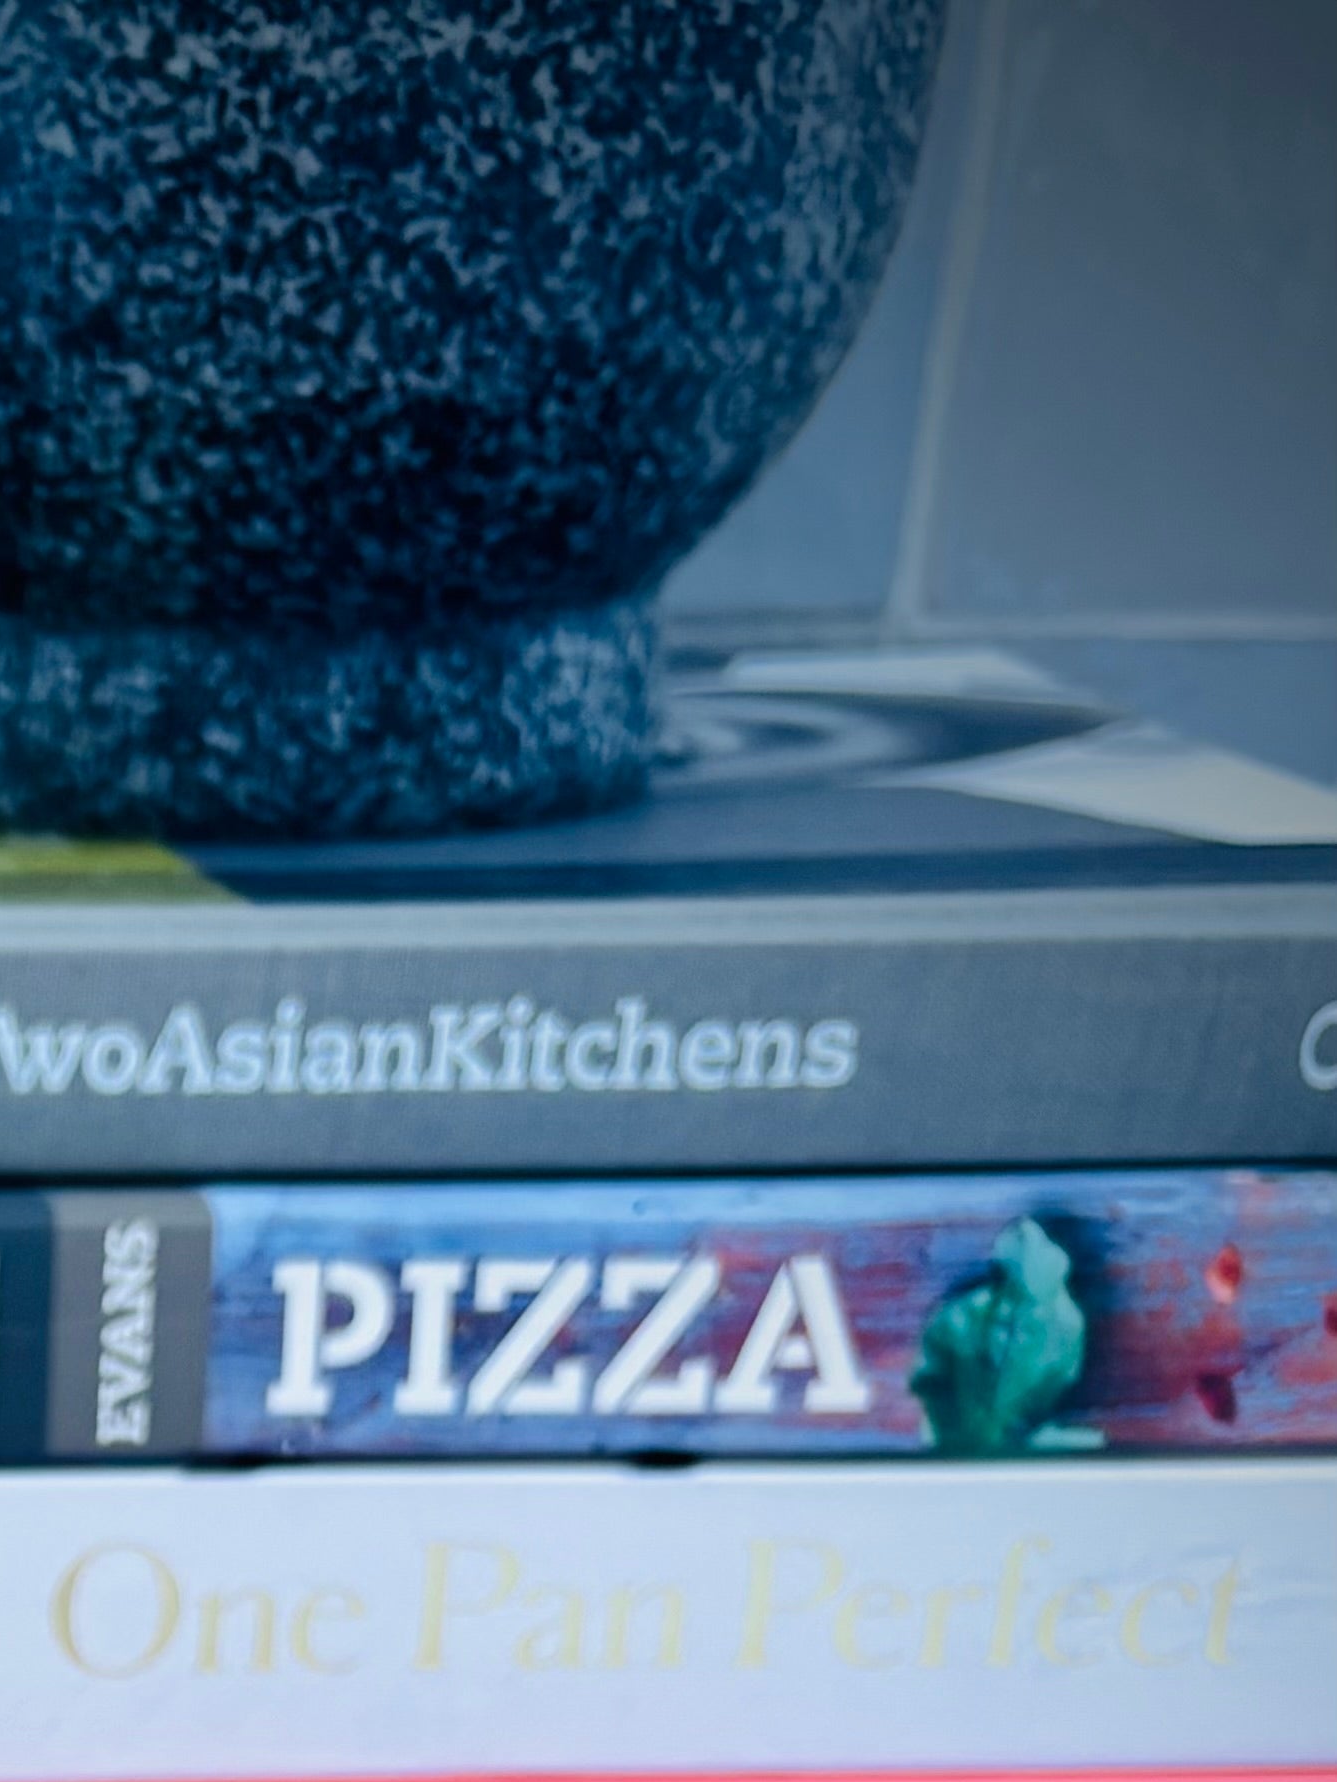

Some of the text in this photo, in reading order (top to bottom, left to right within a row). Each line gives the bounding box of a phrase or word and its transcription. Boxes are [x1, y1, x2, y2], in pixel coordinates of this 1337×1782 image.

[95, 1217, 160, 1446] EVANS
[263, 1252, 872, 1418] PIZZA
[49, 1533, 1249, 1680] One Pan Perfect
